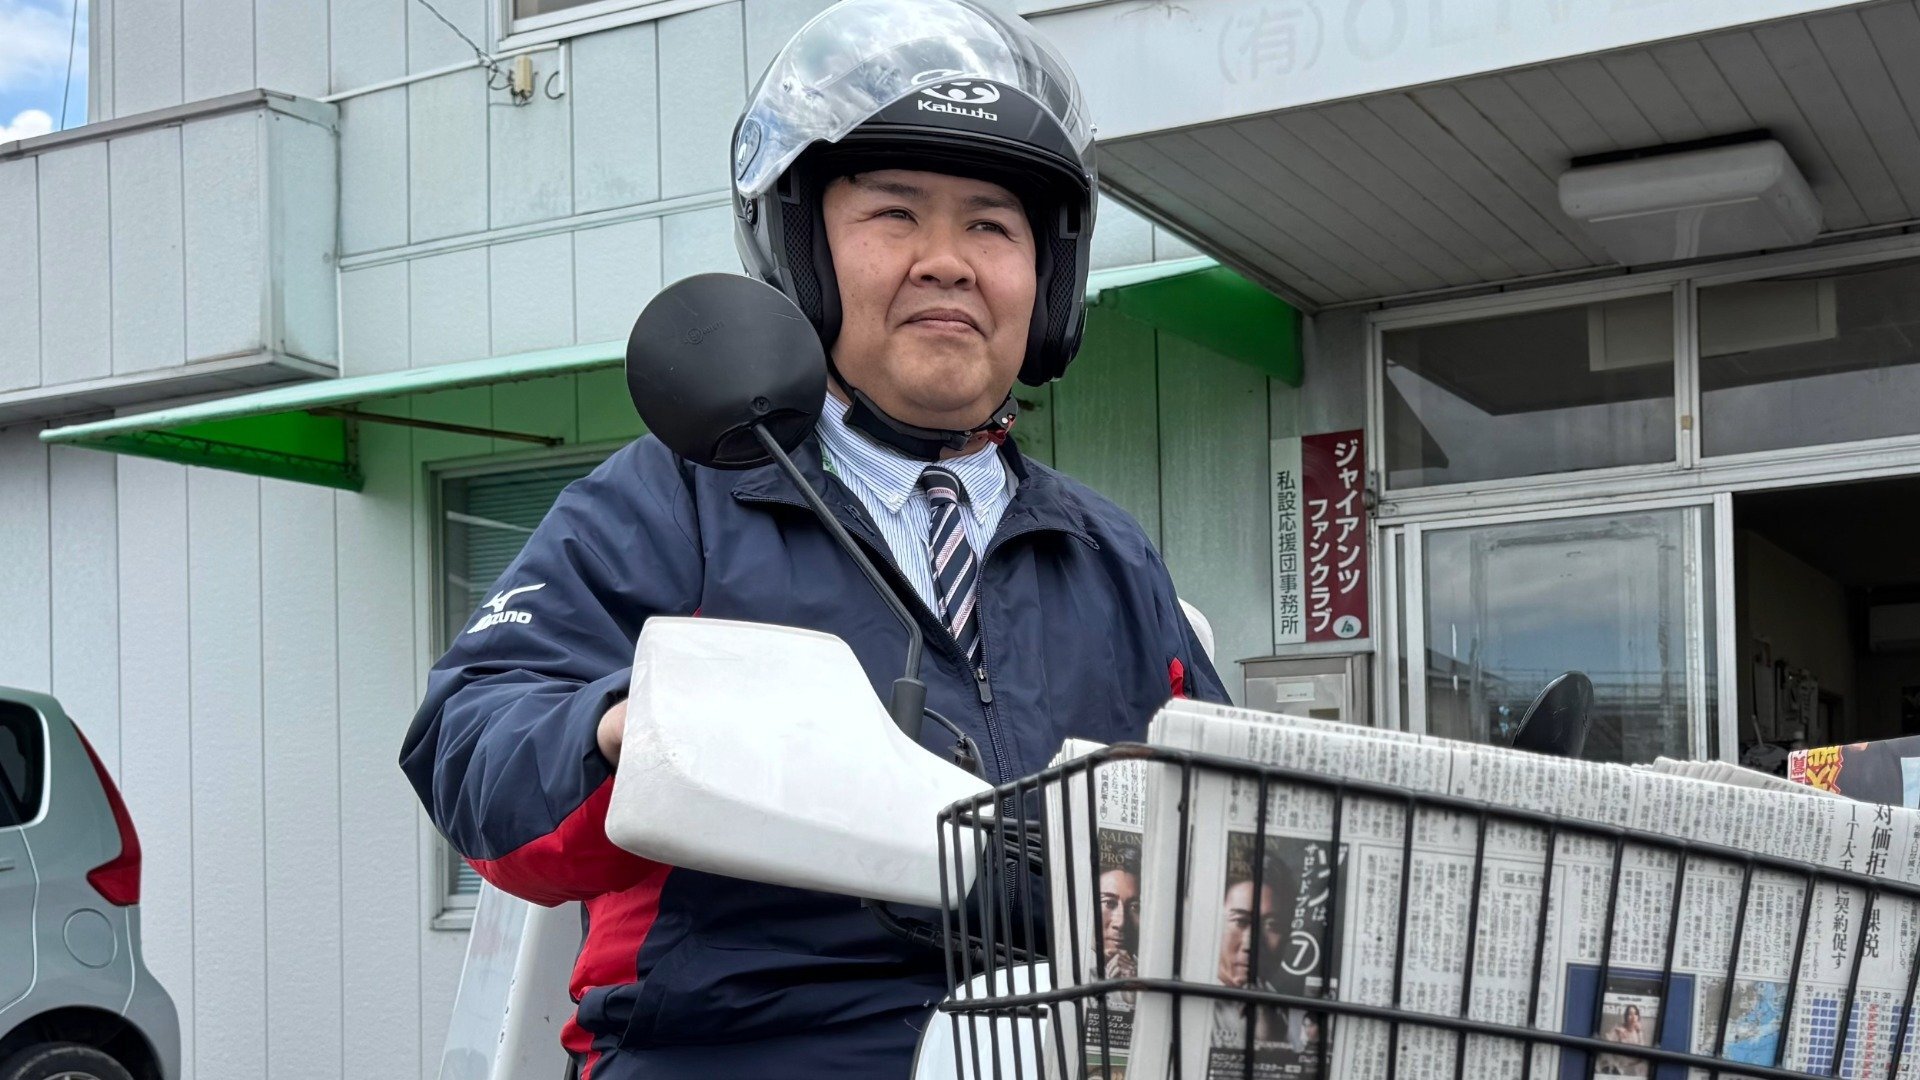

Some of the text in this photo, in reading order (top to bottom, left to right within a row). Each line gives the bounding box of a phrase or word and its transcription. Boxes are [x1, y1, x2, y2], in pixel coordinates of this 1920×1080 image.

[917, 99, 998, 122] Kabuto
[1276, 470, 1299, 635] 私設応援団事務所
[1308, 499, 1332, 633] ファンクラブ
[1334, 439, 1361, 595] ジャイアンツ
[1290, 843, 1318, 929] サロンドプロの
